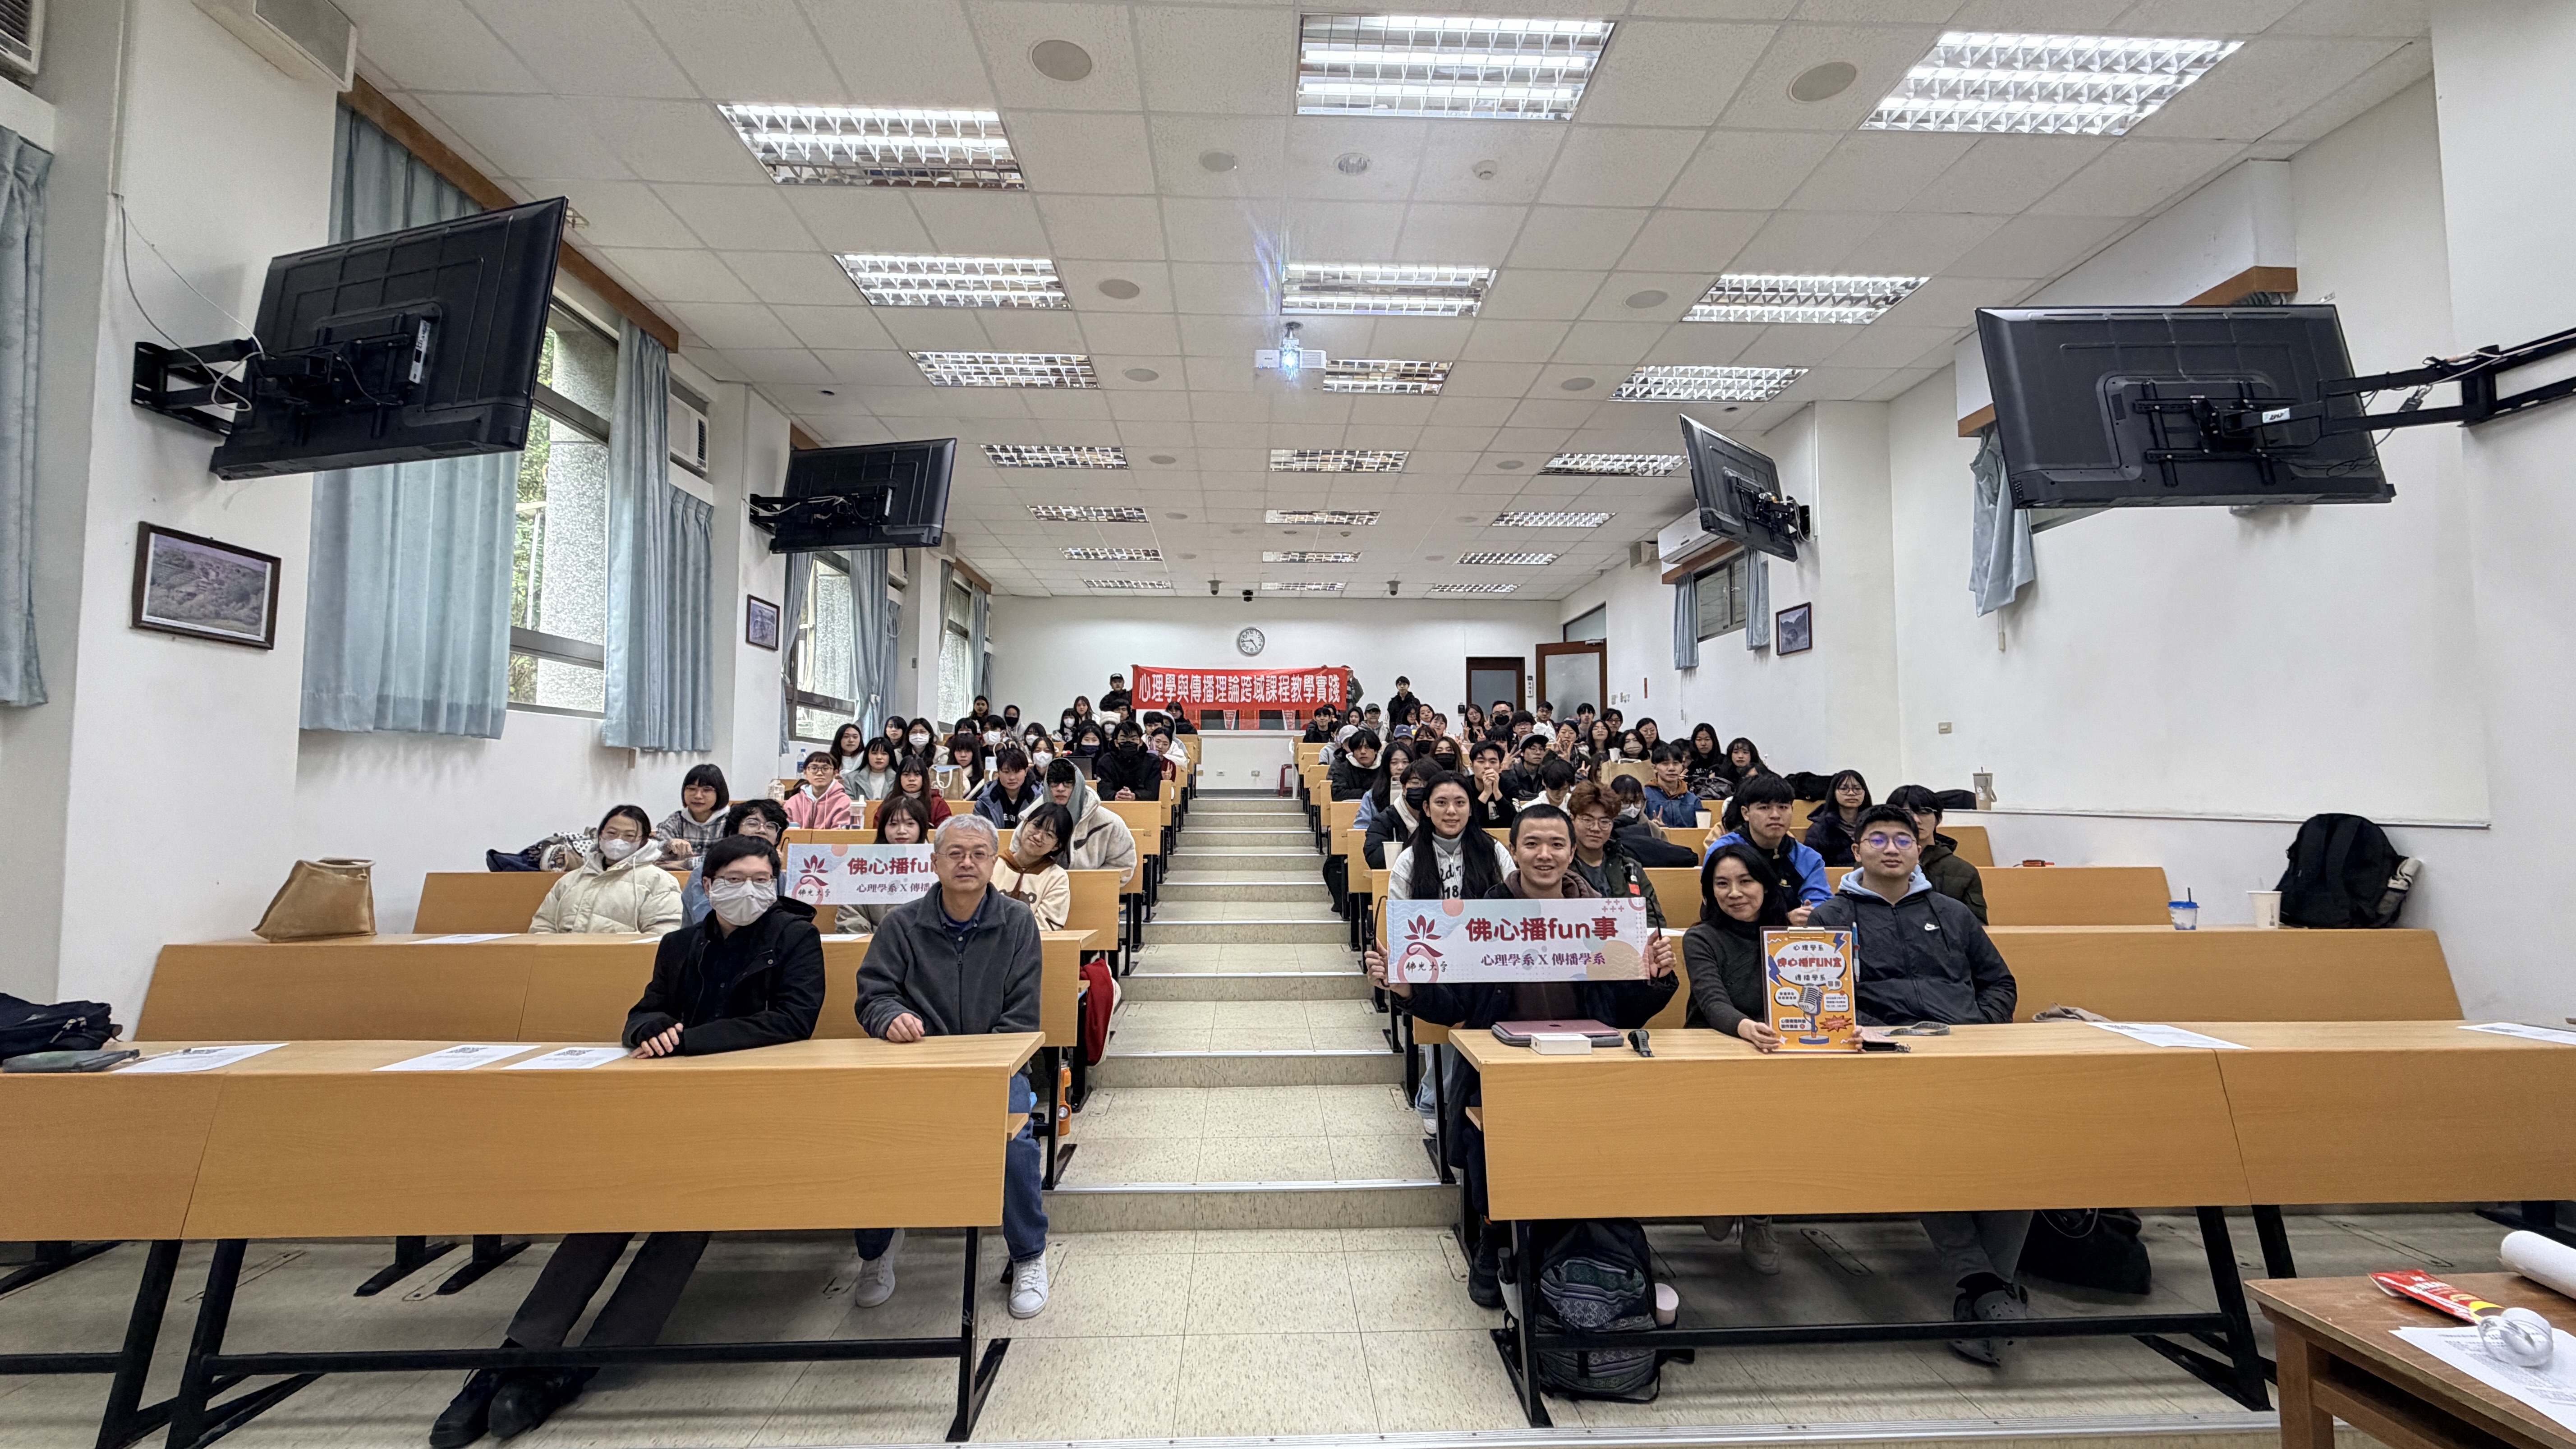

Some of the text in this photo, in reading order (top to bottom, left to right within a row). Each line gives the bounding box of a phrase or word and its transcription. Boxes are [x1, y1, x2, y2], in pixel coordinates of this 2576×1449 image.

[1139, 673, 1340, 703] 心理學與傳播理論跨域課程教學實踐
[856, 882, 934, 892] 心理學系 X 傳播
[1465, 916, 1618, 942] 佛心播fun事
[1481, 952, 1605, 966] 心理學系 X 傳播學系
